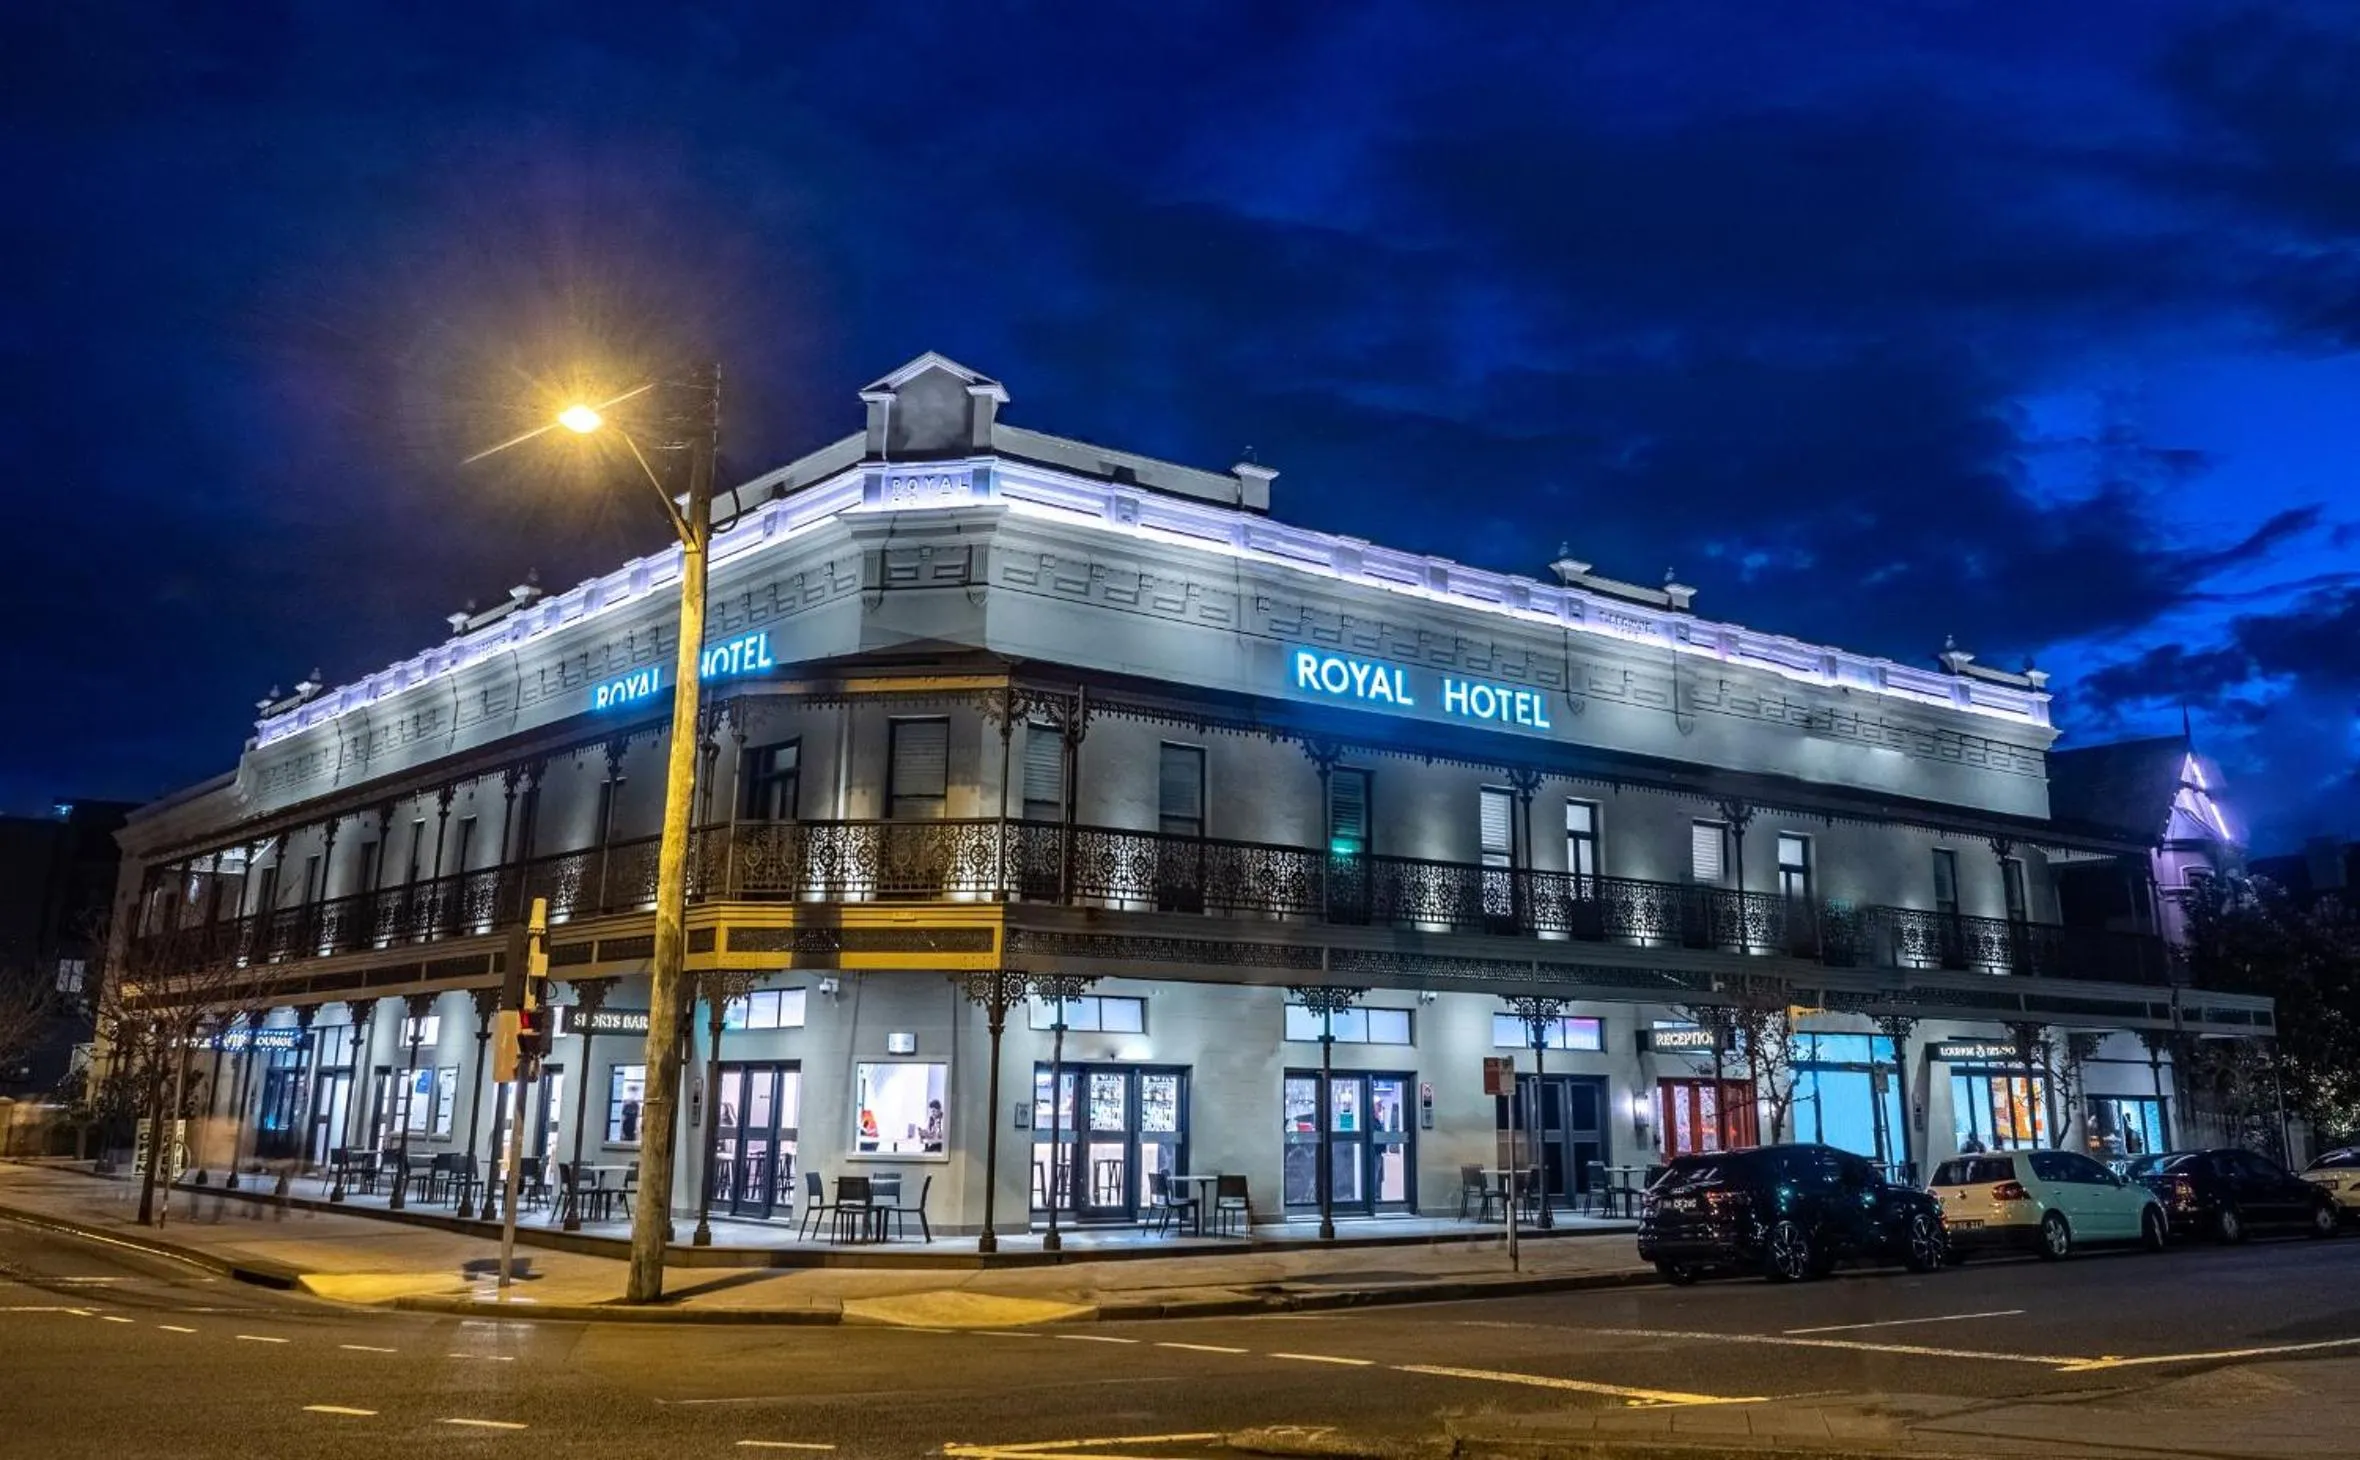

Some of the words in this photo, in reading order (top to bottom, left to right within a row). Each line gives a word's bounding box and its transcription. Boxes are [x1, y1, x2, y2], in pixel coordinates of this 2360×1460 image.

[893, 477, 968, 493] ROYAL
[596, 668, 660, 709] ROYAL
[1297, 652, 1414, 705] ROYAL
[1444, 679, 1550, 728] HOTEL
[622, 1015, 649, 1029] BAR
[255, 1036, 294, 1048] OUNGE
[136, 1132, 150, 1172] OPEN
